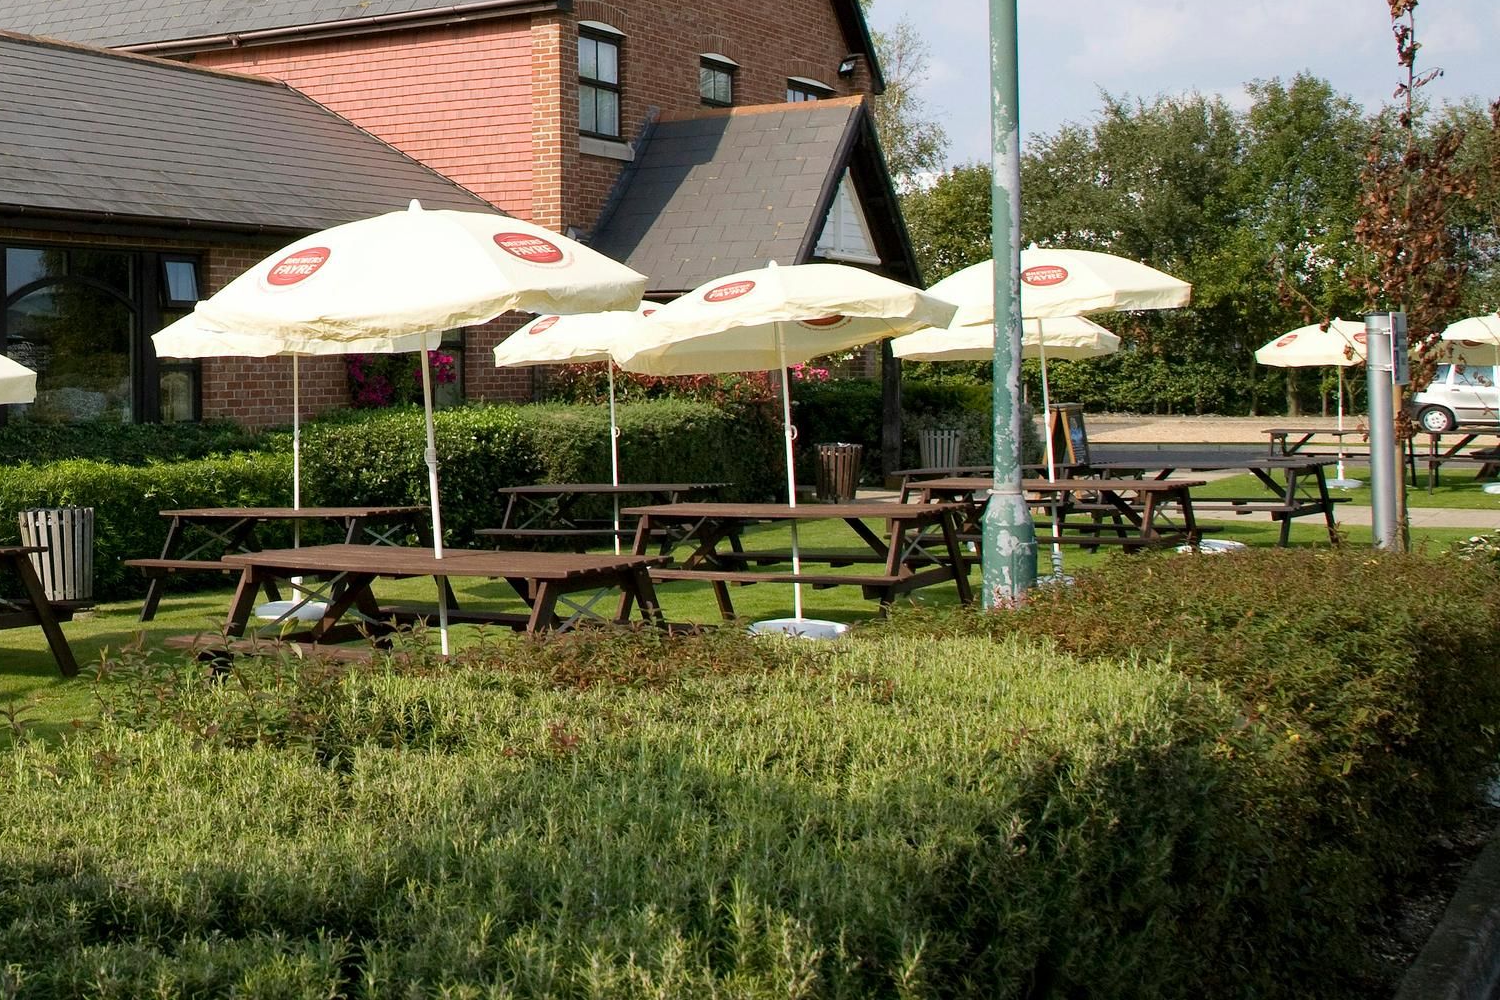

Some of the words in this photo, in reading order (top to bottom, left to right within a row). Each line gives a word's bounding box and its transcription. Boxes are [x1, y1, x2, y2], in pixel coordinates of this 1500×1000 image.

[508, 245, 556, 255] FAYRE
[273, 264, 318, 275] FAYRE
[1027, 273, 1064, 282] FAYRE
[708, 288, 748, 299] FAYRE
